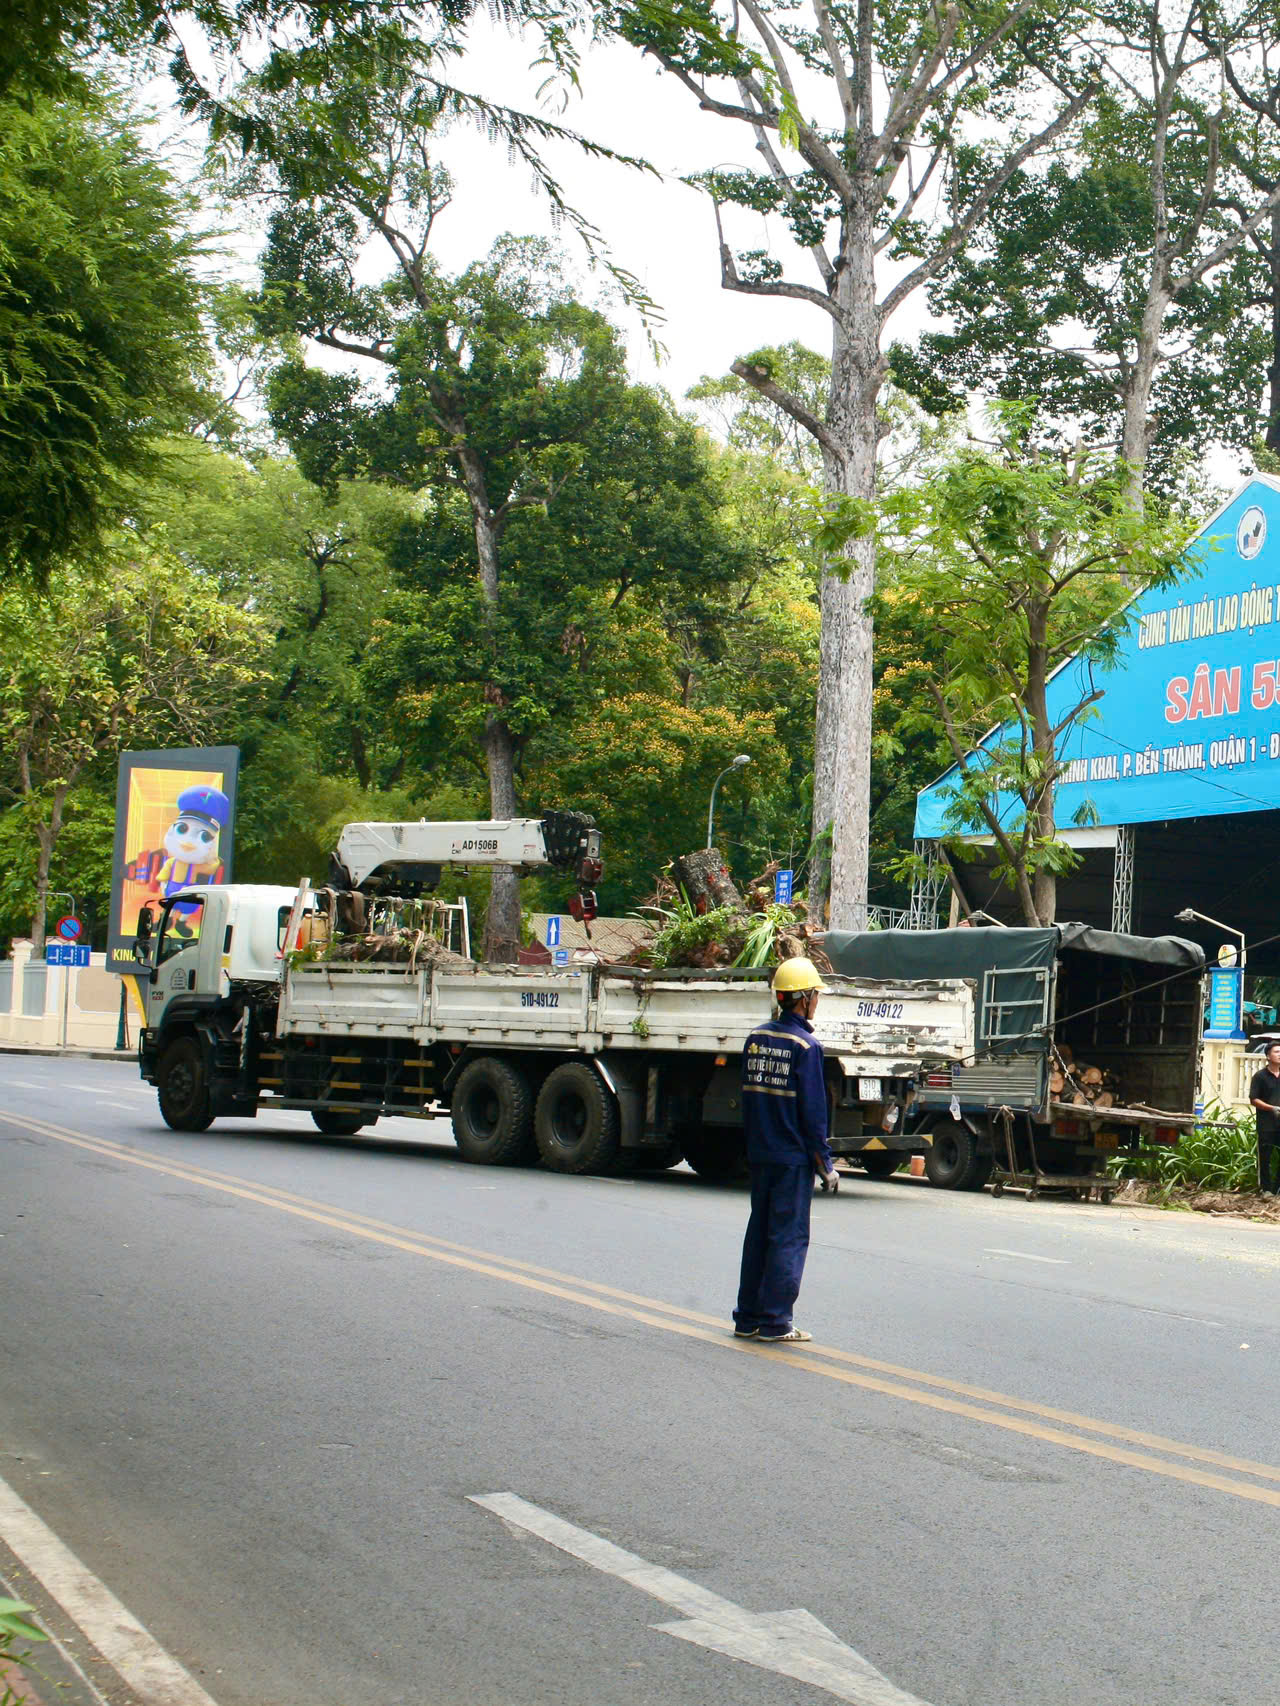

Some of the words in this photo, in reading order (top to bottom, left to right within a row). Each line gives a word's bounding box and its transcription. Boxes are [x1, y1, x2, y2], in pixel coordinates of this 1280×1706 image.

[1138, 609, 1167, 650] CUNG
[1169, 600, 1192, 644] VĂN
[1192, 593, 1214, 640] HÓA
[1216, 594, 1239, 634] LAO
[1240, 581, 1273, 636] ĐỘNG
[1165, 663, 1241, 723] SÂN
[1090, 753, 1120, 782] KHAI,
[1122, 754, 1133, 778] P.
[1135, 743, 1160, 777] BẾN
[1162, 740, 1206, 773] THÀNH,
[1209, 733, 1246, 770] QUẬN
[1249, 736, 1257, 763] 1
[462, 840, 498, 850] AD1506B
